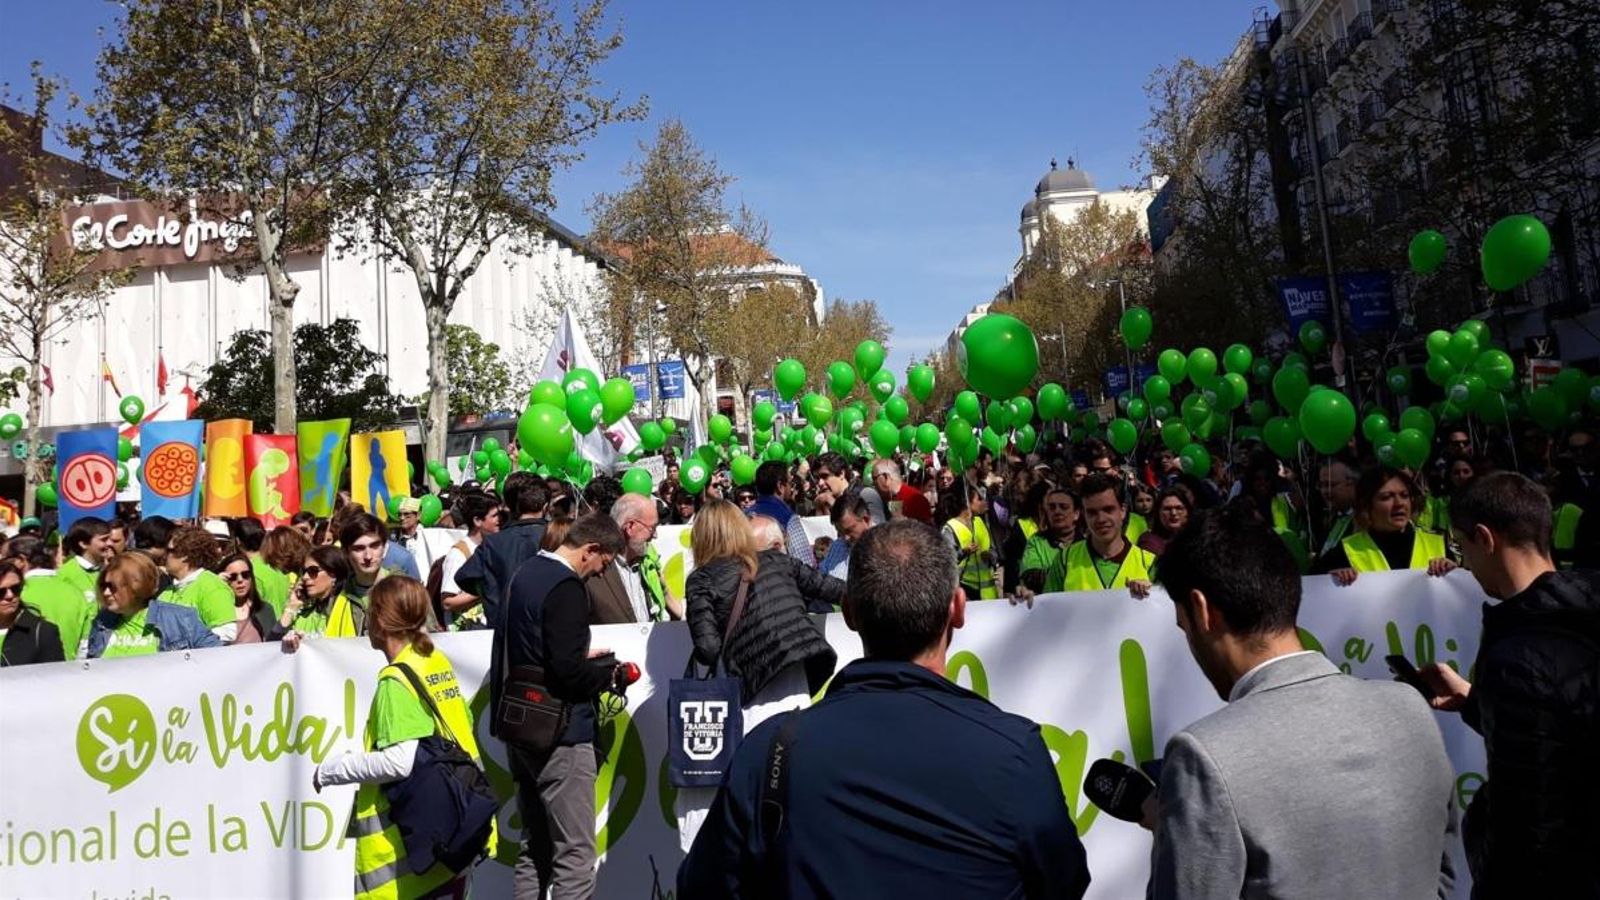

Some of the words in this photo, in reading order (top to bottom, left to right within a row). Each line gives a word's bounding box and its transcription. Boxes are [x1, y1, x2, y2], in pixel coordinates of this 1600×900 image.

[72, 215, 105, 252] El
[105, 214, 181, 249] Corte
[183, 198, 284, 258] Ingl
[88, 706, 151, 774] Sí
[167, 705, 192, 728] a
[199, 677, 357, 770] Vida!
[683, 723, 724, 731] FRANCISCO
[695, 730, 724, 738] VITORIA
[161, 727, 200, 765] la
[769, 742, 784, 790] SONY
[0, 810, 118, 866] ional
[133, 807, 193, 859] de
[207, 803, 249, 854] la
